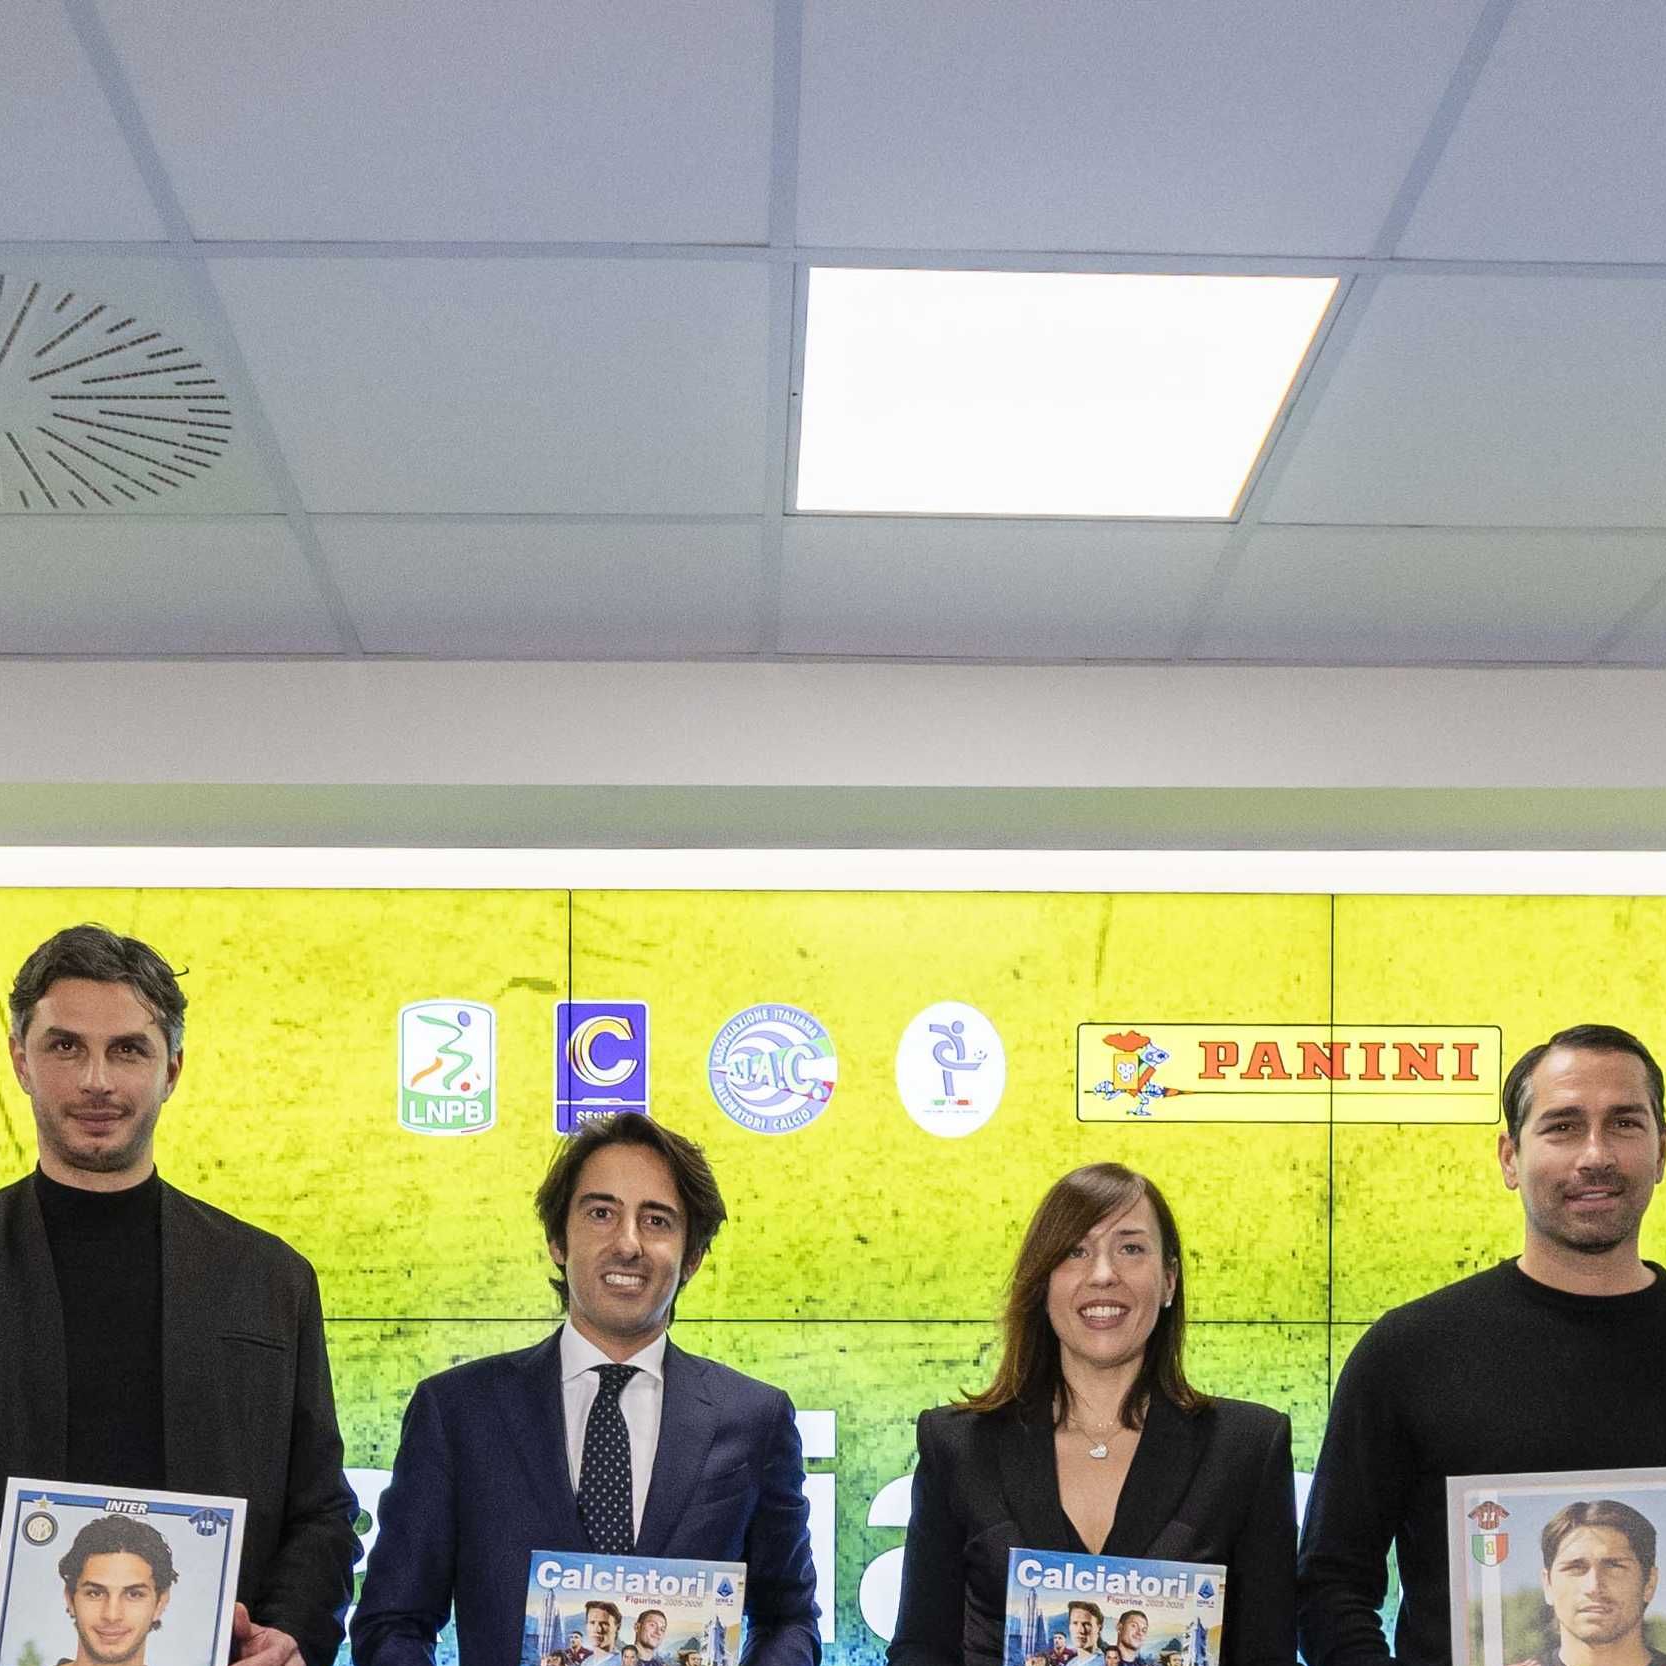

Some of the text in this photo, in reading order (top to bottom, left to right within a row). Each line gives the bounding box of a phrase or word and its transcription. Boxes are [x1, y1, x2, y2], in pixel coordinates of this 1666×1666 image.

[1198, 1041, 1480, 1081] PANINI
[408, 1100, 485, 1125] LNPB
[773, 1108, 814, 1130] CALCIO
[104, 1500, 149, 1515] INTER
[200, 1520, 214, 1530] 15
[536, 1560, 706, 1598] Calciatori
[1016, 1558, 1189, 1600] Calciatori
